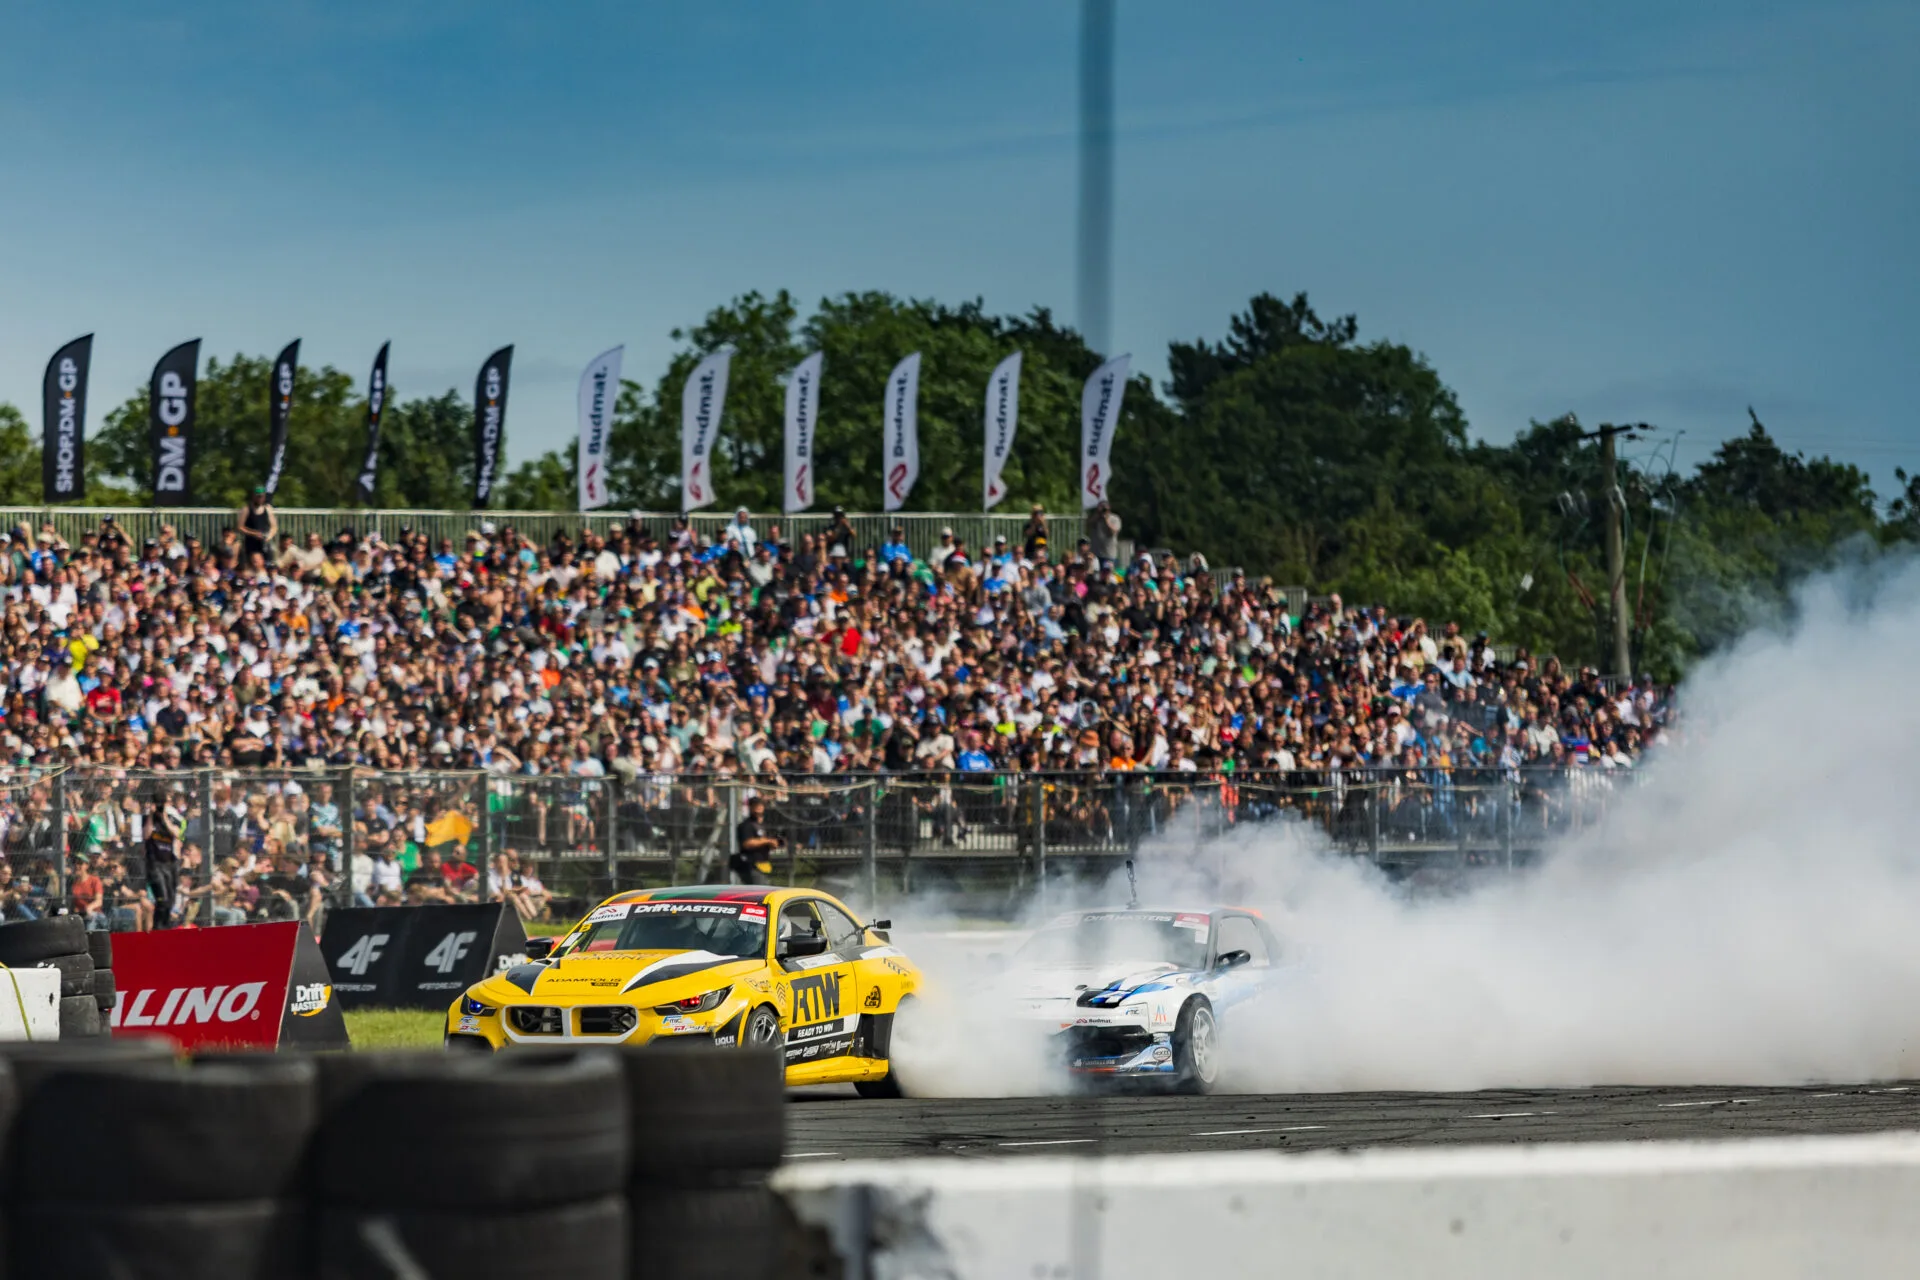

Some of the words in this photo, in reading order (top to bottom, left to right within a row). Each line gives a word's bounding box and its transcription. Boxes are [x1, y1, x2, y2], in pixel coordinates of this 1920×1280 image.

[588, 366, 608, 454] Budmat.
[337, 934, 390, 975] 4F
[424, 932, 478, 973] 4F
[296, 983, 326, 1002] Drift
[333, 982, 377, 992] FSTORE.COM
[291, 1000, 327, 1012] MASTERS
[797, 1026, 815, 1038] READY
[815, 1026, 823, 1034] TO
[824, 1023, 834, 1033] WIN
